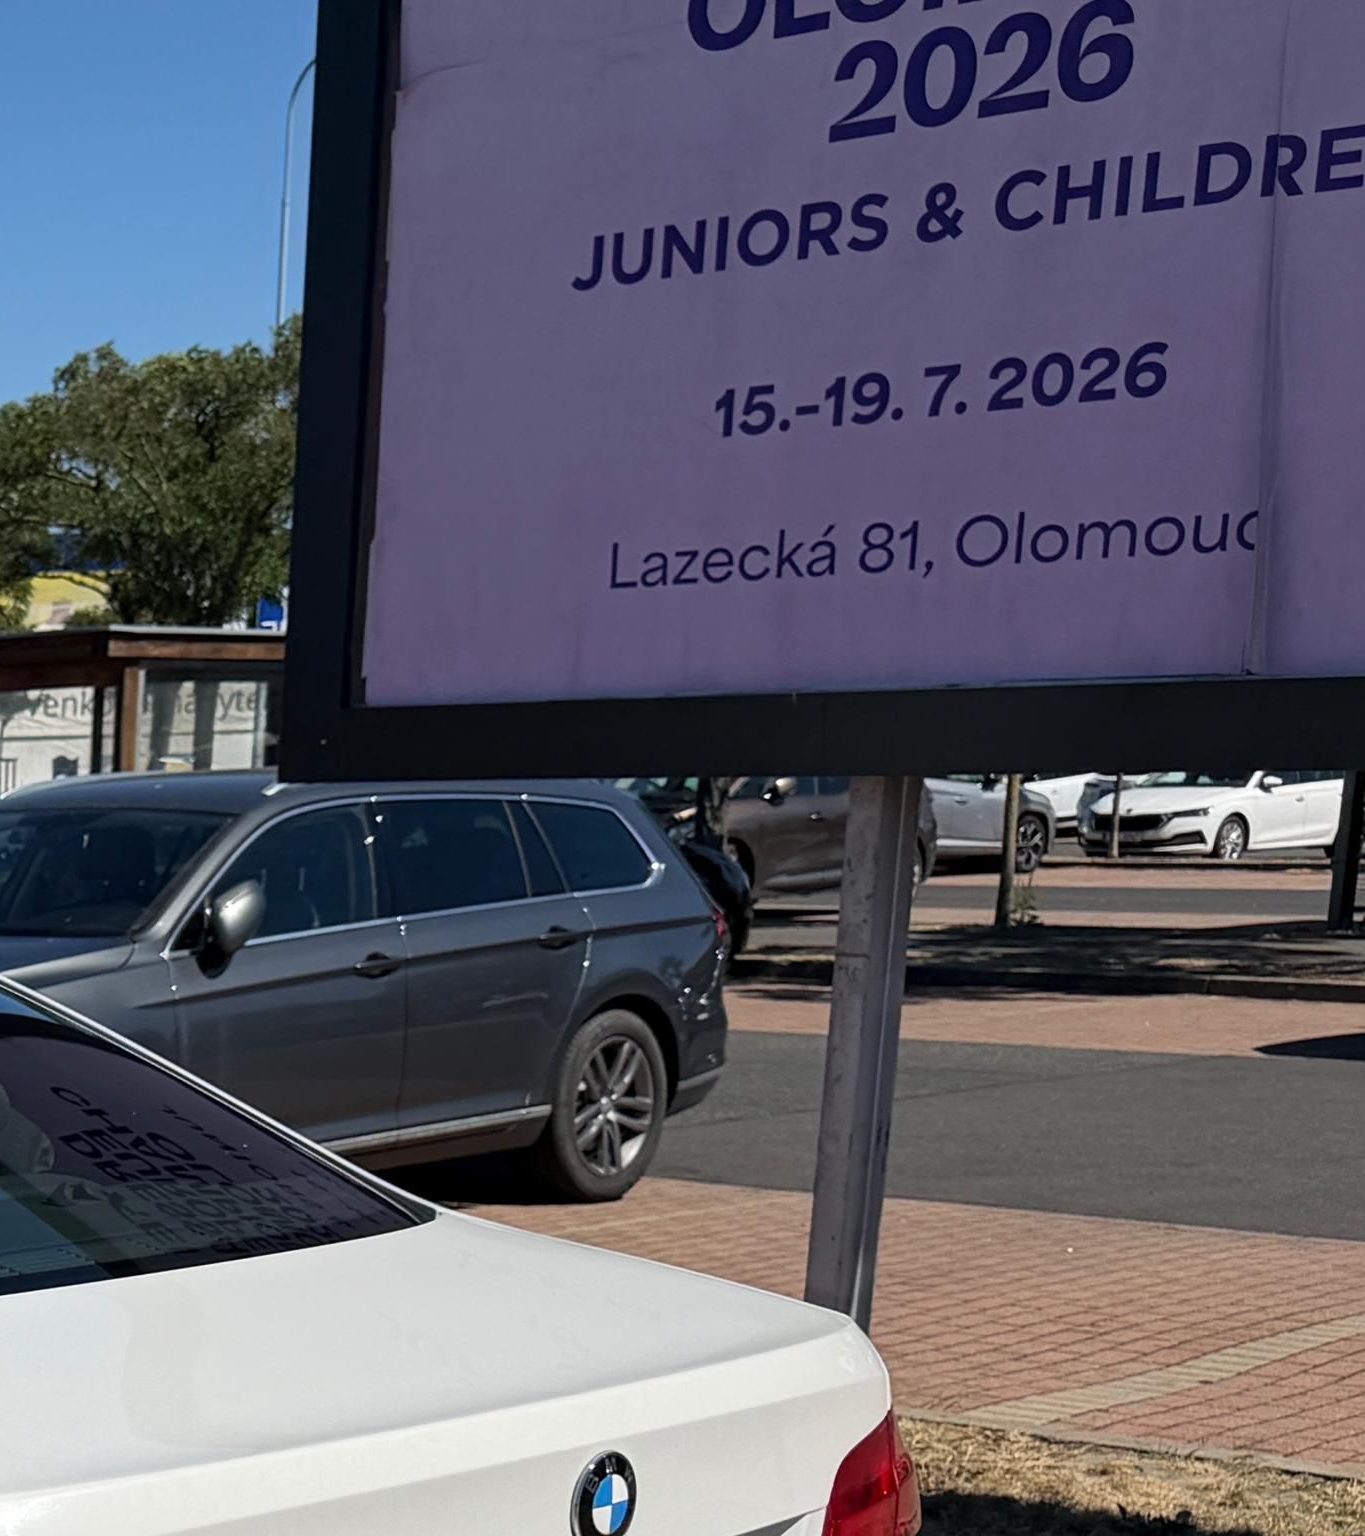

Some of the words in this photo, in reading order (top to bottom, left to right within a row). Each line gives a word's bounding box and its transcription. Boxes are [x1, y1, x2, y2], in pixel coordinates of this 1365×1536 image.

[829, 0, 1134, 143] 2026
[572, 194, 889, 292] JUNIORS
[917, 182, 965, 244] &
[987, 342, 1169, 412] 2026
[610, 521, 837, 590] Lazecká
[859, 521, 934, 579] 81,
